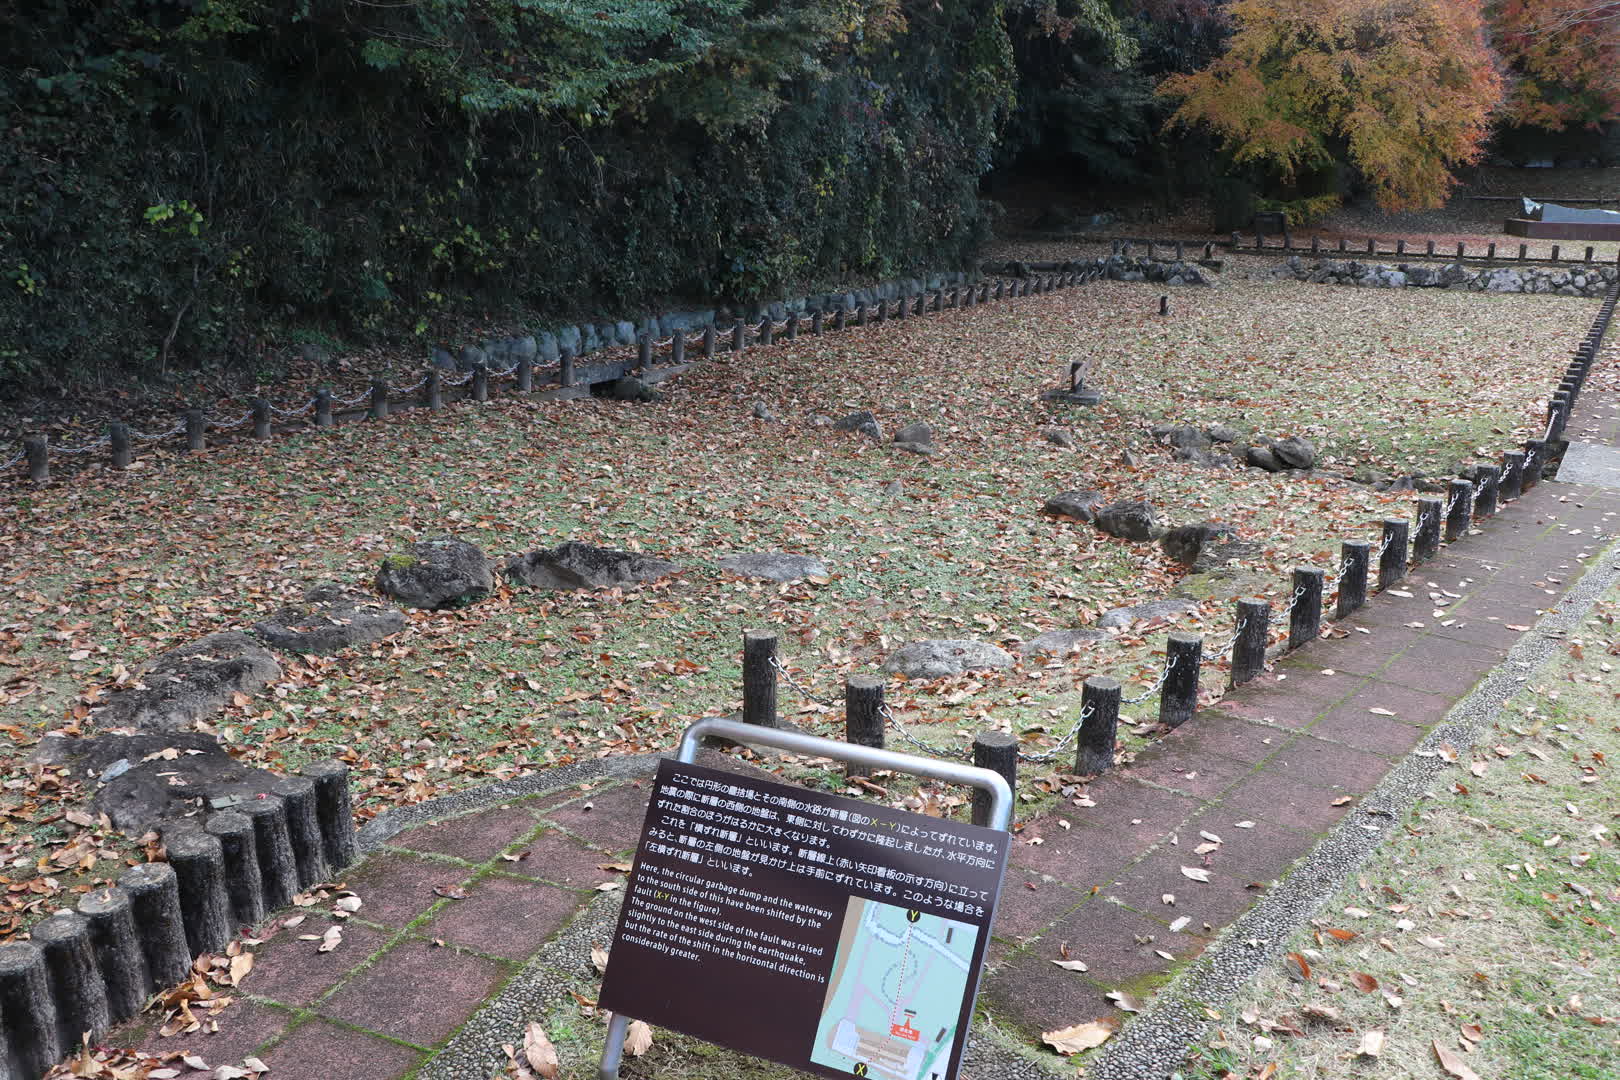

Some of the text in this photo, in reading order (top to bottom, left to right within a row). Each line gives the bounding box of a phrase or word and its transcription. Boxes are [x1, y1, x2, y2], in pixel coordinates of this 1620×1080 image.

[657, 799, 830, 849] ずれた割合のほうがはるかに大きくなります。
[634, 885, 722, 916] fault (X-Y in the figure).
[640, 862, 832, 920] Here, the circular garbage dump and the waterway
[647, 876, 659, 885] the
[660, 880, 681, 891] south
[683, 886, 698, 896] side
[700, 891, 708, 899] of
[709, 893, 724, 904] this
[726, 897, 744, 908] have
[745, 902, 764, 914] been
[766, 907, 795, 922] shifted
[796, 916, 806, 927] by
[808, 919, 821, 928] the
[622, 933, 700, 962] considerably greater.
[625, 920, 638, 930] but
[639, 925, 654, 934] the
[653, 930, 668, 939] rate
[679, 936, 691, 945] the
[693, 939, 711, 952] shift
[712, 944, 720, 953] in
[721, 948, 734, 958] the
[736, 950, 777, 971] horizontal
[779, 964, 815, 981] direction
[818, 974, 825, 983] is
[628, 909, 657, 924] slightly
[667, 920, 679, 929] the
[681, 925, 697, 935] east
[698, 929, 714, 939] side
[715, 932, 742, 948] during
[744, 942, 757, 951] the
[758, 947, 806, 965] earthquake,
[632, 897, 823, 956] The ground on the west side of the fault was raised
